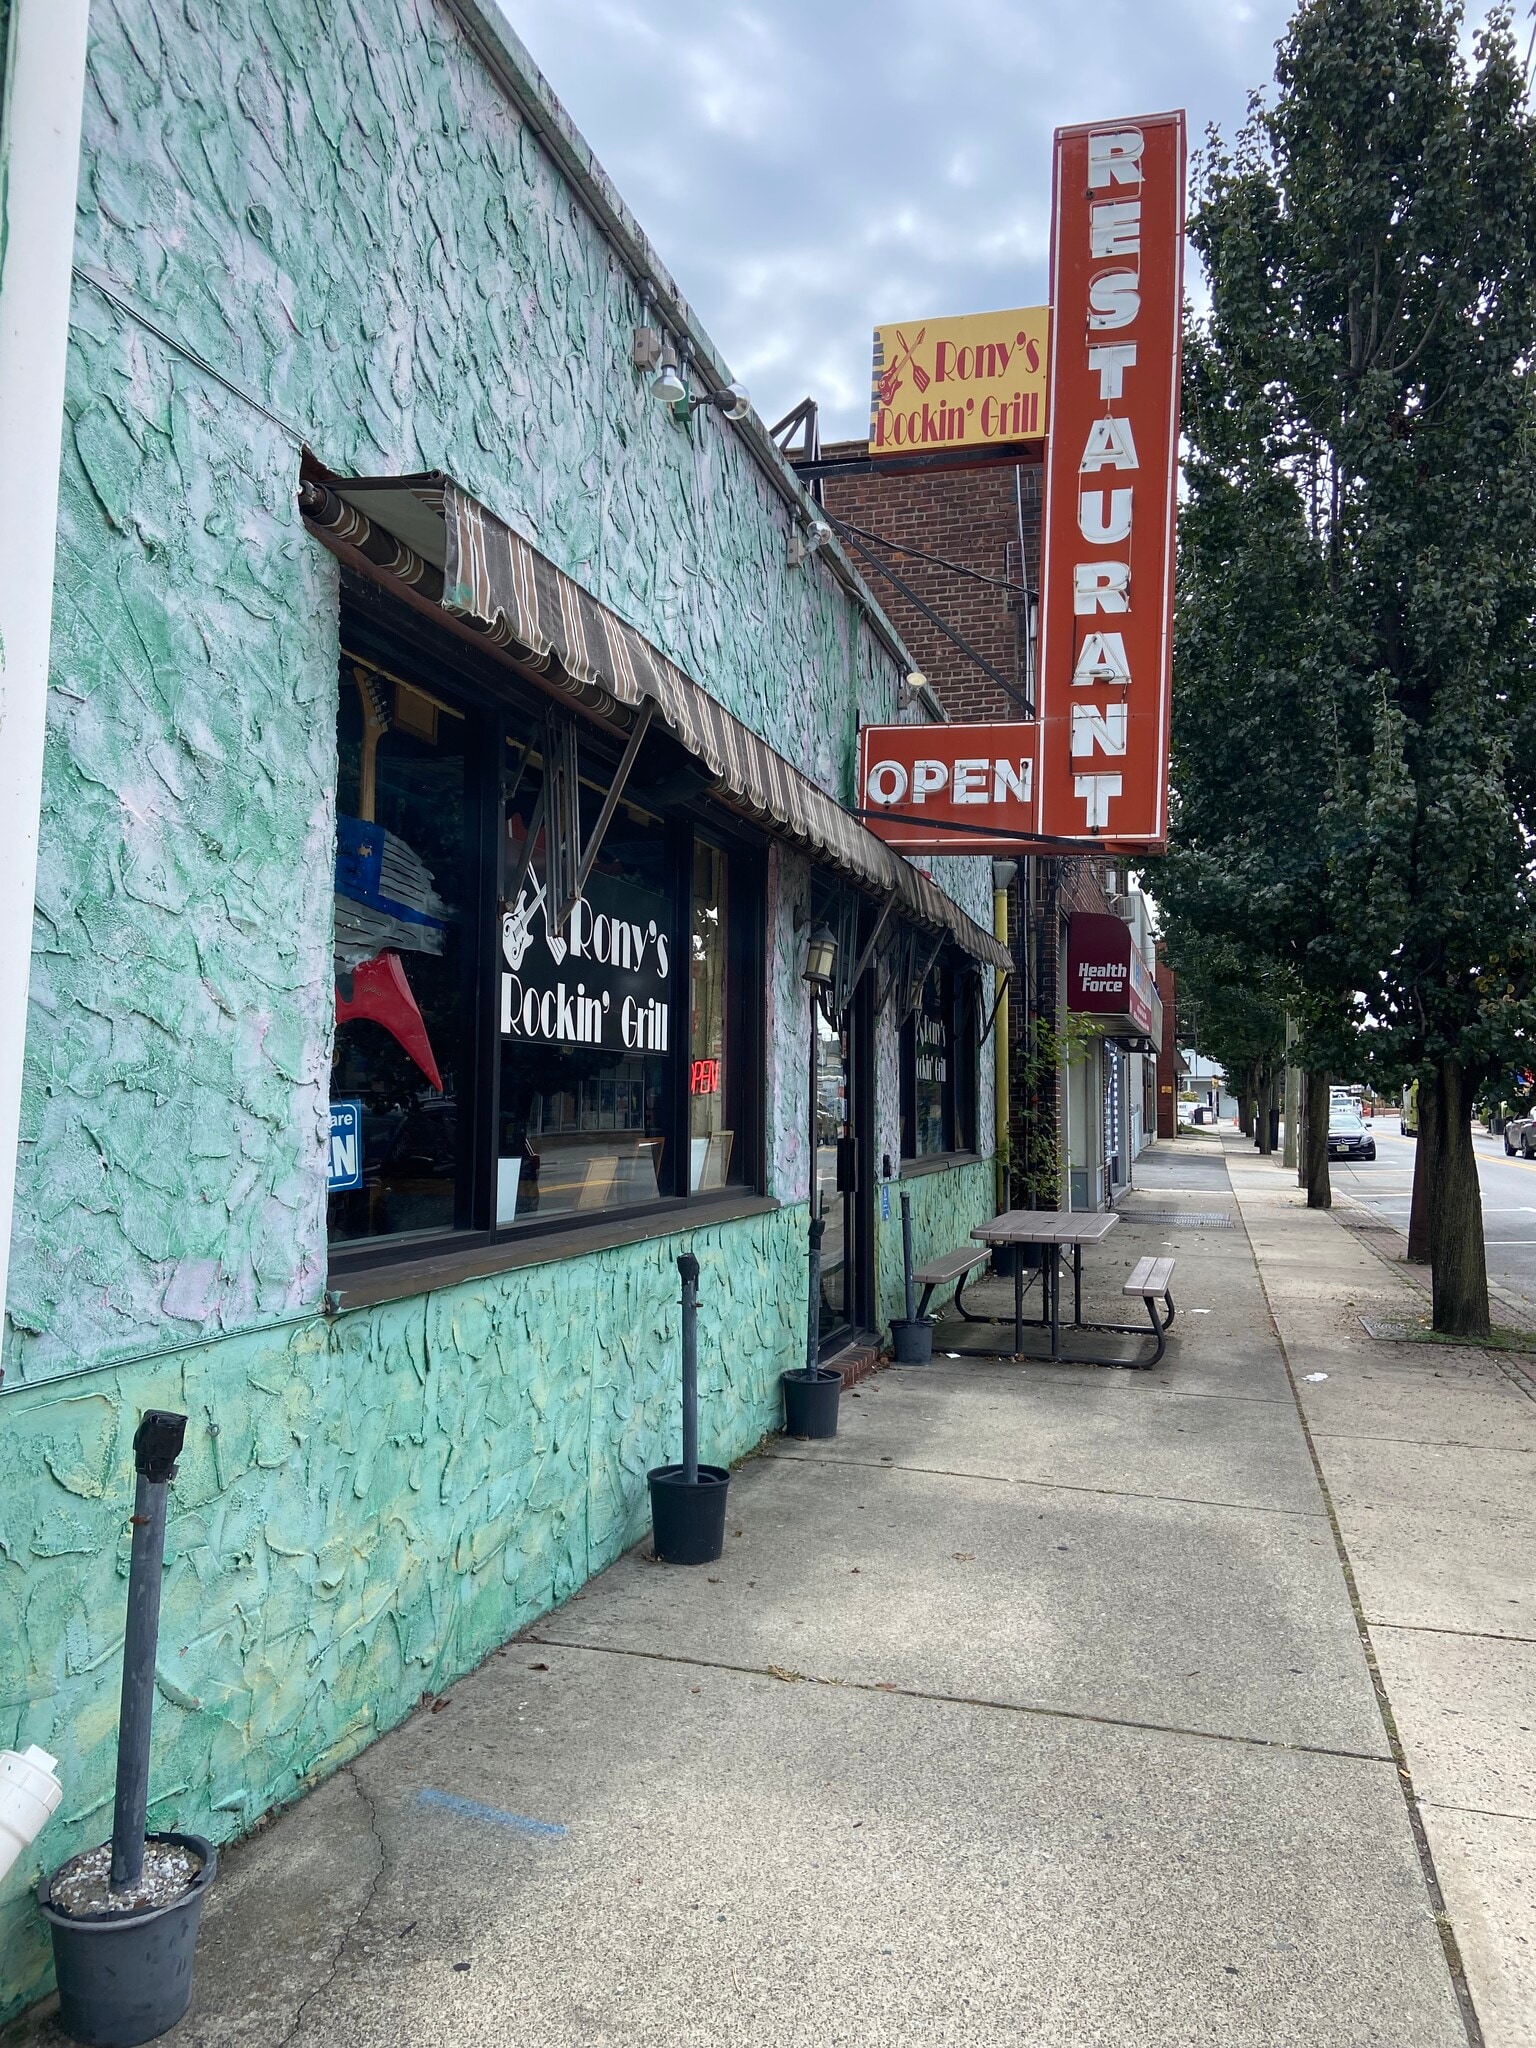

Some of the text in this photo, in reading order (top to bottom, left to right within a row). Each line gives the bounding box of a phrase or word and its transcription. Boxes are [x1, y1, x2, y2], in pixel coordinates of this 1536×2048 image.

[935, 331, 1040, 384] Rony's
[876, 392, 1039, 447] Rockin' Grill
[1071, 129, 1146, 828] RESTAURANT
[867, 757, 1034, 805] OPEN
[569, 896, 669, 979] Rony's
[1078, 963, 1127, 978] Health
[1082, 977, 1123, 992] Force
[500, 971, 669, 1052] Rockin' Grill
[690, 1060, 719, 1096] PEN
